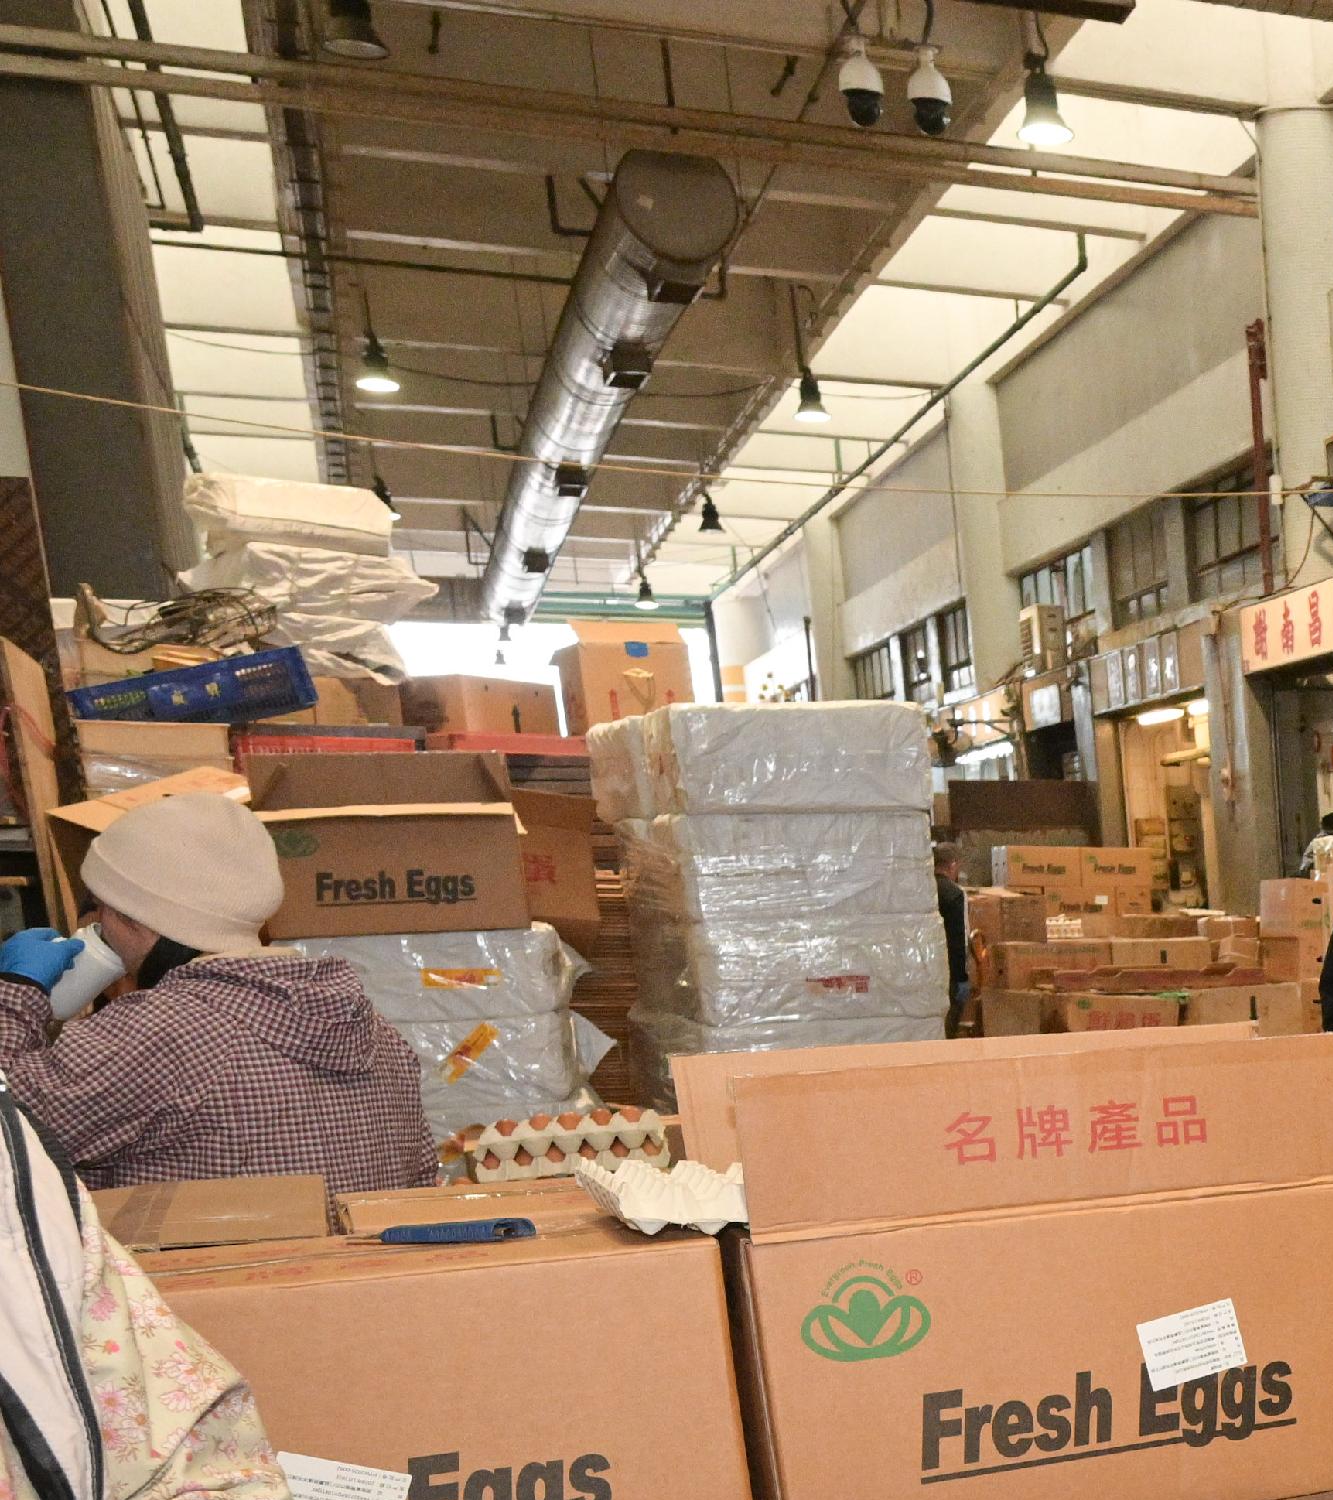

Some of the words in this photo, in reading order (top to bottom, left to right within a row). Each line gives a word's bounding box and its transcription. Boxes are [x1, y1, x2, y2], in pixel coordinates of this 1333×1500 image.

[315, 871, 396, 901] Fresh
[406, 869, 476, 904] Eggs
[944, 1095, 1207, 1165] 名牌產品
[859, 1259, 884, 1271] Fresh
[921, 1371, 1112, 1471] Fresh
[1138, 1361, 1293, 1447] Eggs
